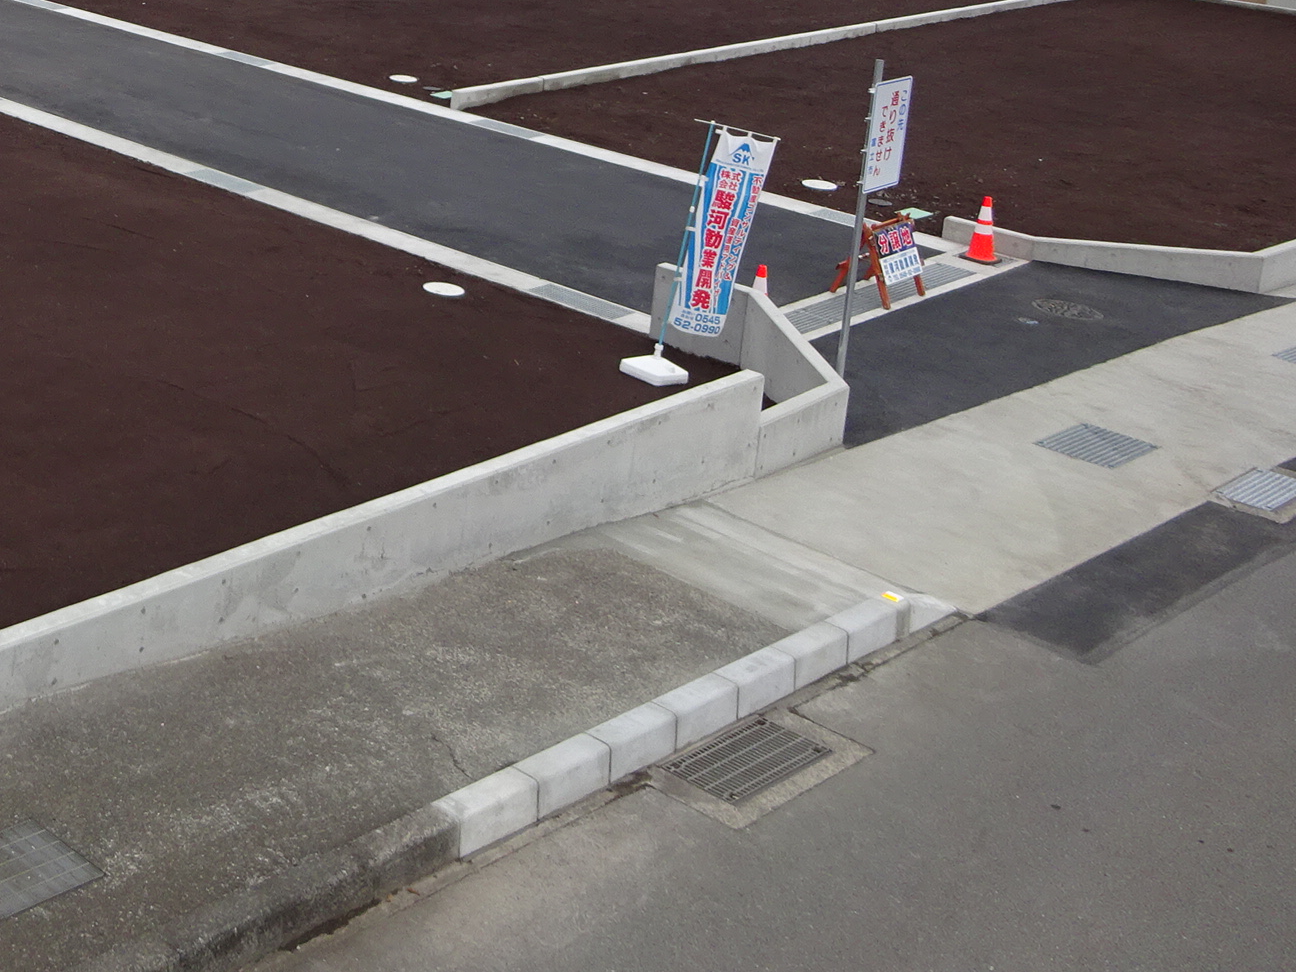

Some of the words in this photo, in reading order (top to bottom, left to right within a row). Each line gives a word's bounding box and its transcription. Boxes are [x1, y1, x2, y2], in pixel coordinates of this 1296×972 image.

[883, 90, 900, 160] 通り抜け
[873, 105, 889, 176] できません
[732, 153, 751, 166] SK
[690, 190, 735, 309] 駿河勧業開発
[877, 227, 913, 254] 分譲地
[674, 317, 721, 334] 52-0990
[695, 313, 720, 325] 0545
